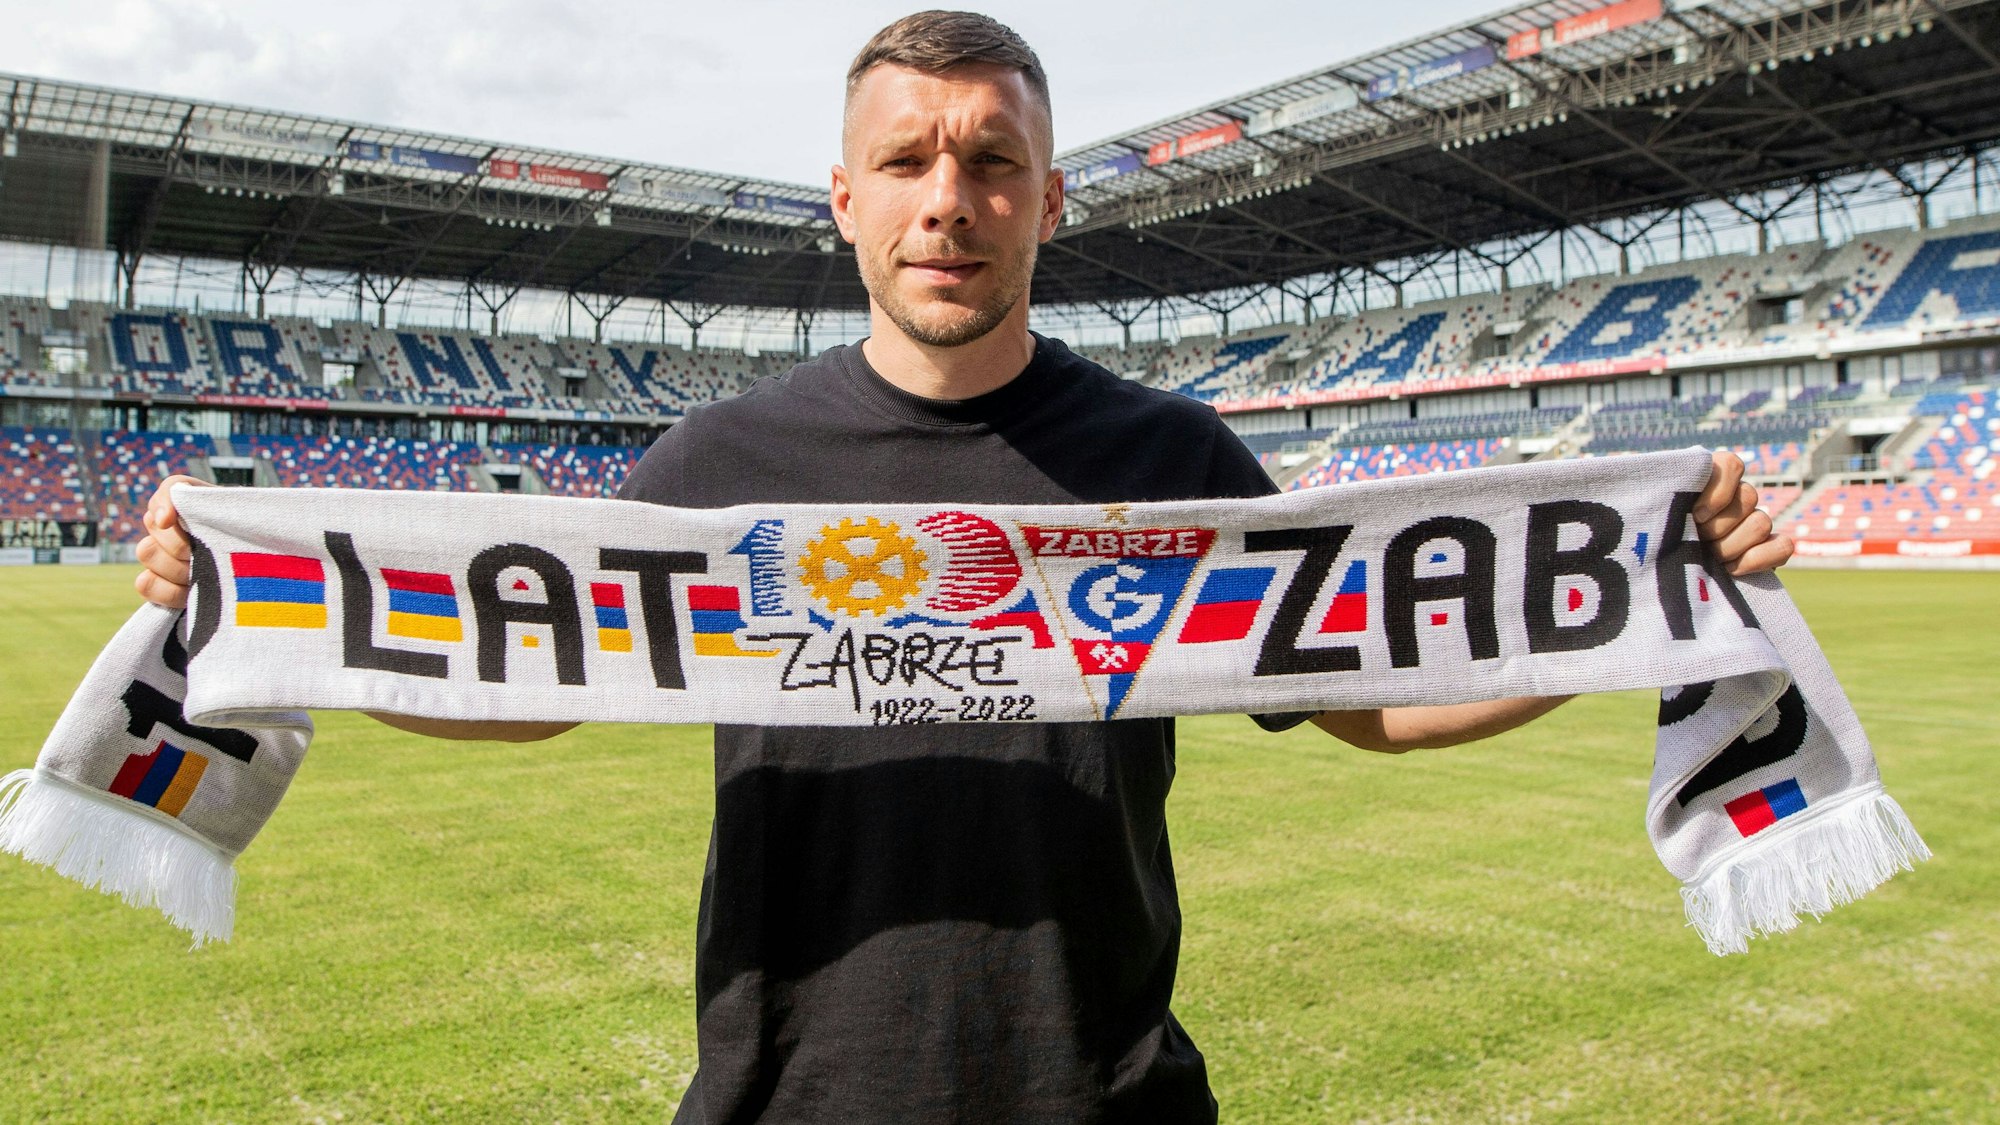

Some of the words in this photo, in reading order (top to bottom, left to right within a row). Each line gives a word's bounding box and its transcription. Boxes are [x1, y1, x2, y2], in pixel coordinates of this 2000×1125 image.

[535, 172, 582, 187] LENTNER
[1039, 530, 1199, 557] ZABRZE
[325, 531, 708, 690] LAT
[746, 627, 1023, 711] ZABRZE
[869, 694, 1037, 727] 1922-2022
